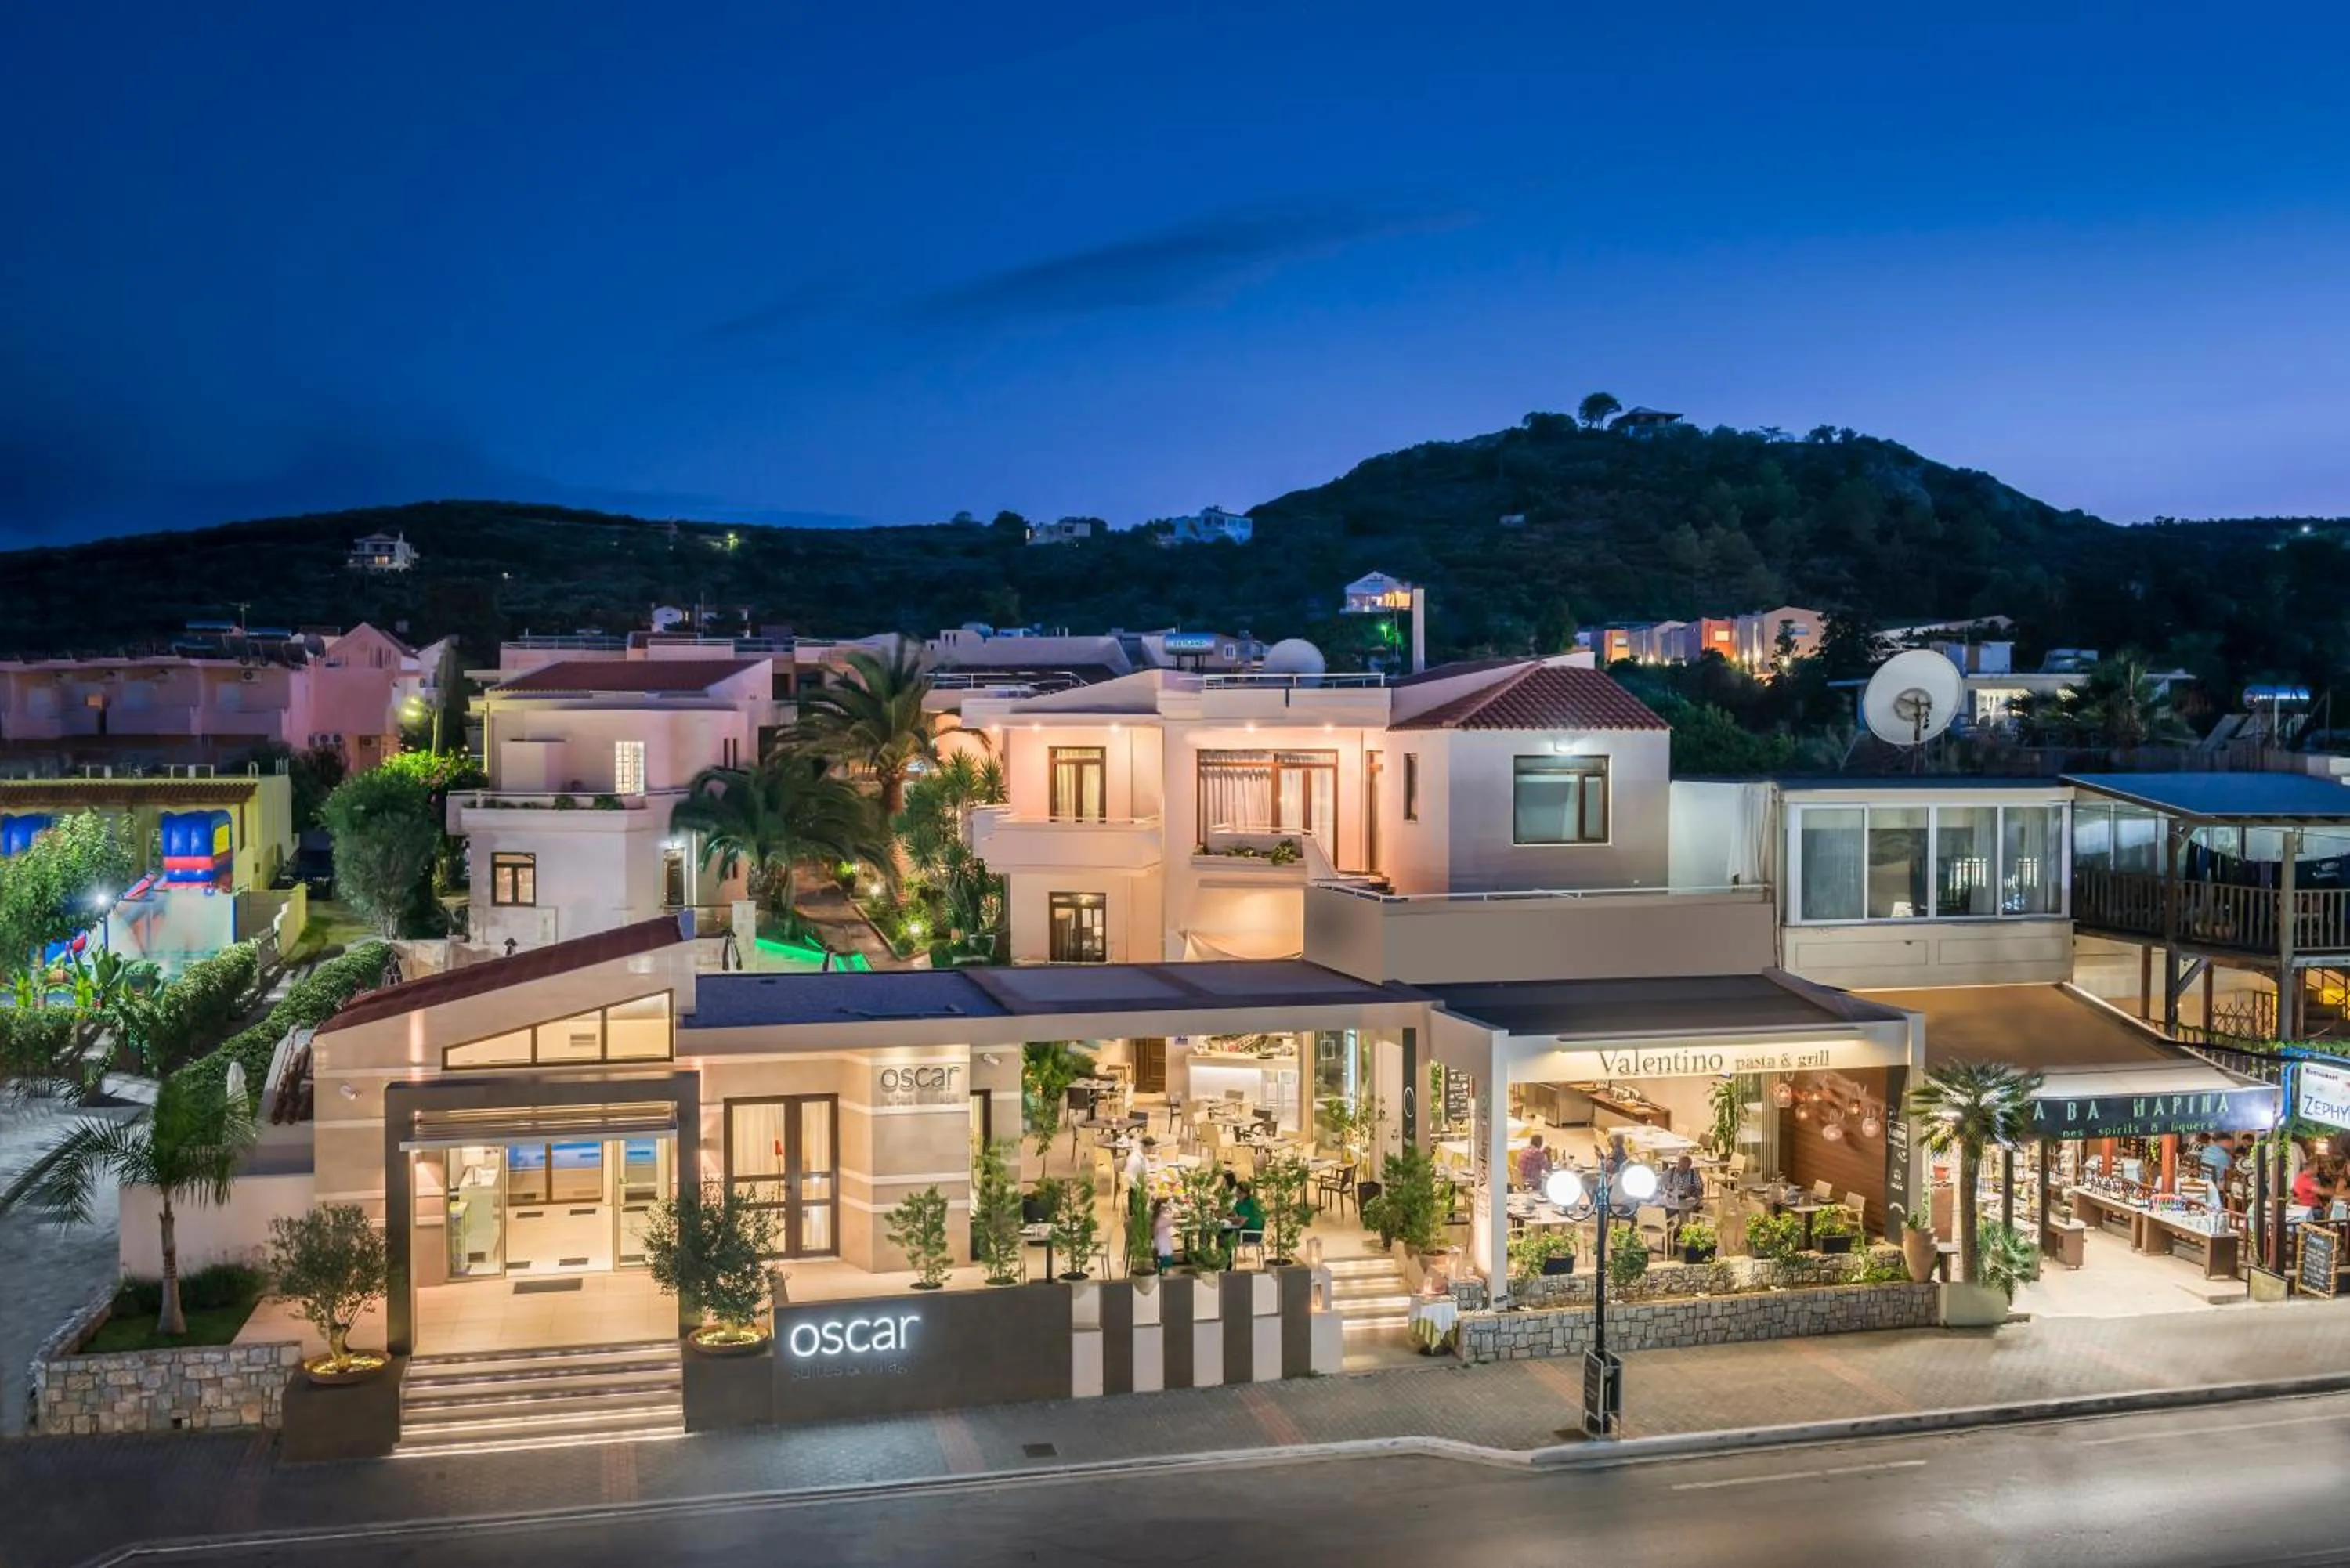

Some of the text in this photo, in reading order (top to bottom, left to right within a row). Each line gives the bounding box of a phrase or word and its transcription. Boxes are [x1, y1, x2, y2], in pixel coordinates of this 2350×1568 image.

[1597, 1047, 1828, 1075] Valentino pasta & grill
[881, 1066, 959, 1091] oscar
[2305, 1094, 2350, 1122] ZEPHY
[2063, 1129, 2084, 1138] nes
[2098, 1123, 2140, 1136] spirits
[790, 1315, 920, 1357] oscar
